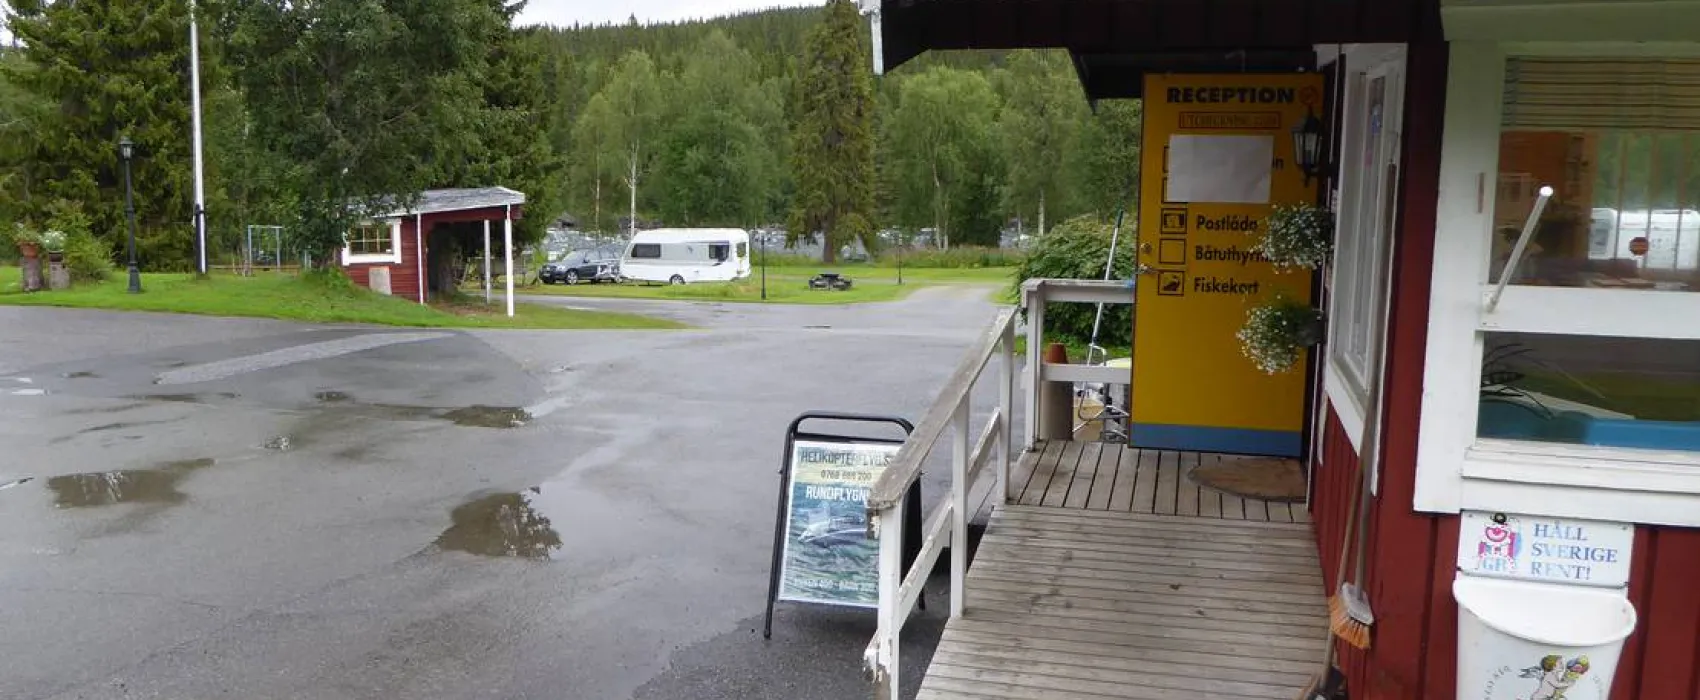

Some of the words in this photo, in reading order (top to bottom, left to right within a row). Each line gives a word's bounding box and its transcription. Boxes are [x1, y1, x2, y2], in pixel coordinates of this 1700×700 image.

[1167, 87, 1295, 104] RECEPTION
[1196, 214, 1258, 231] Postlåda
[1193, 277, 1260, 295] Fiskekort
[1534, 519, 1588, 541] HÅLL
[1531, 543, 1618, 563] SVERIGE
[1530, 561, 1592, 580] RENT!
